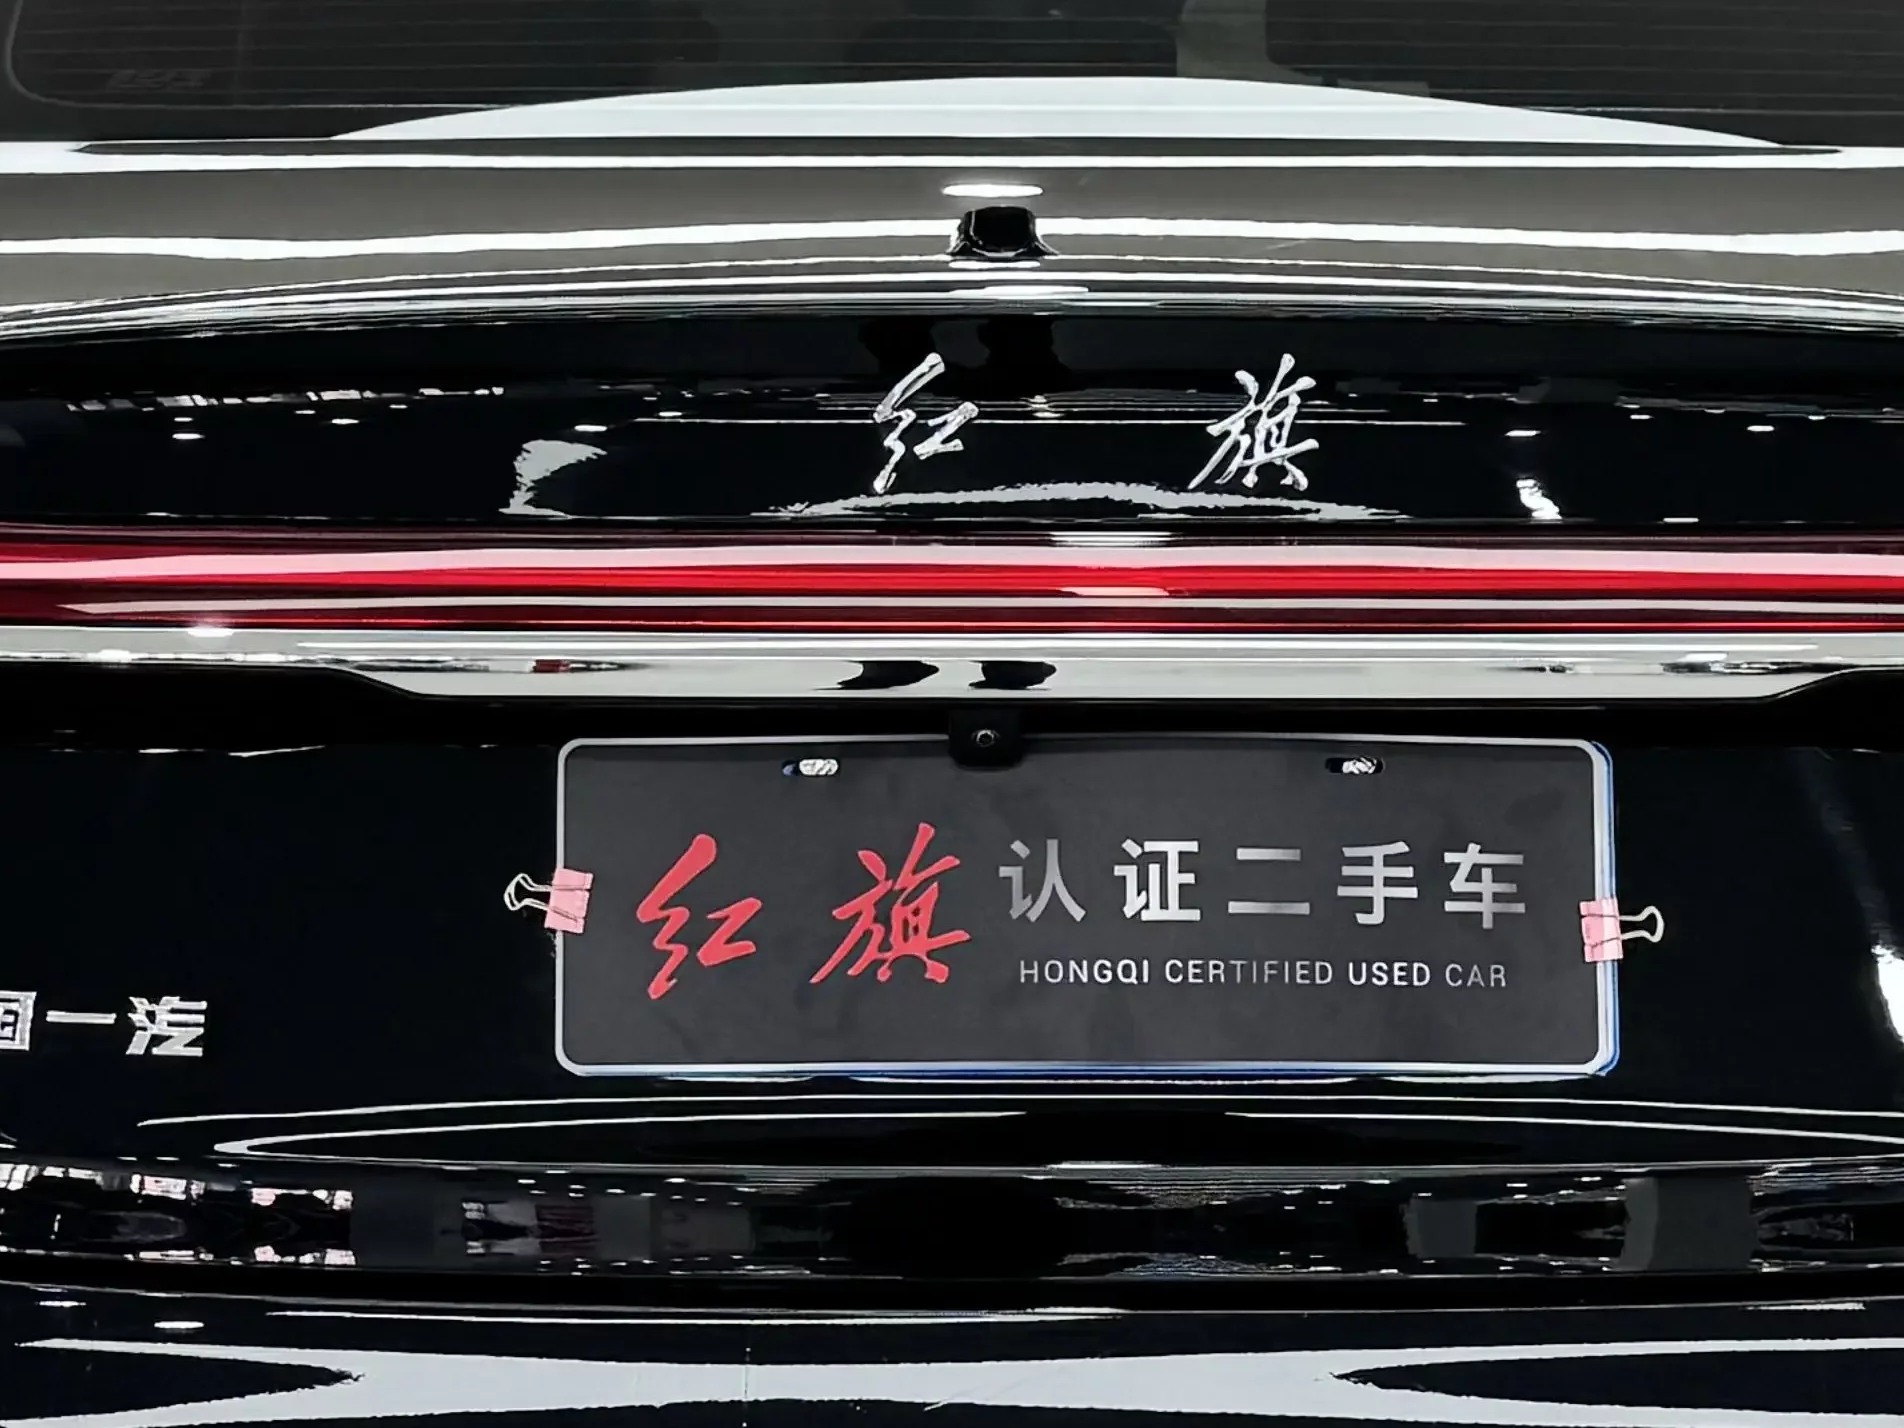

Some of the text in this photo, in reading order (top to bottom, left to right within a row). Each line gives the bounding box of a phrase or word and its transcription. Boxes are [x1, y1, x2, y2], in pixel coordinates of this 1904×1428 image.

[871, 351, 1319, 494] 红旗
[635, 821, 1528, 999] 红旗 认证二手车
[1019, 958, 1507, 988] HONGQI CERTIFIED USED CAR
